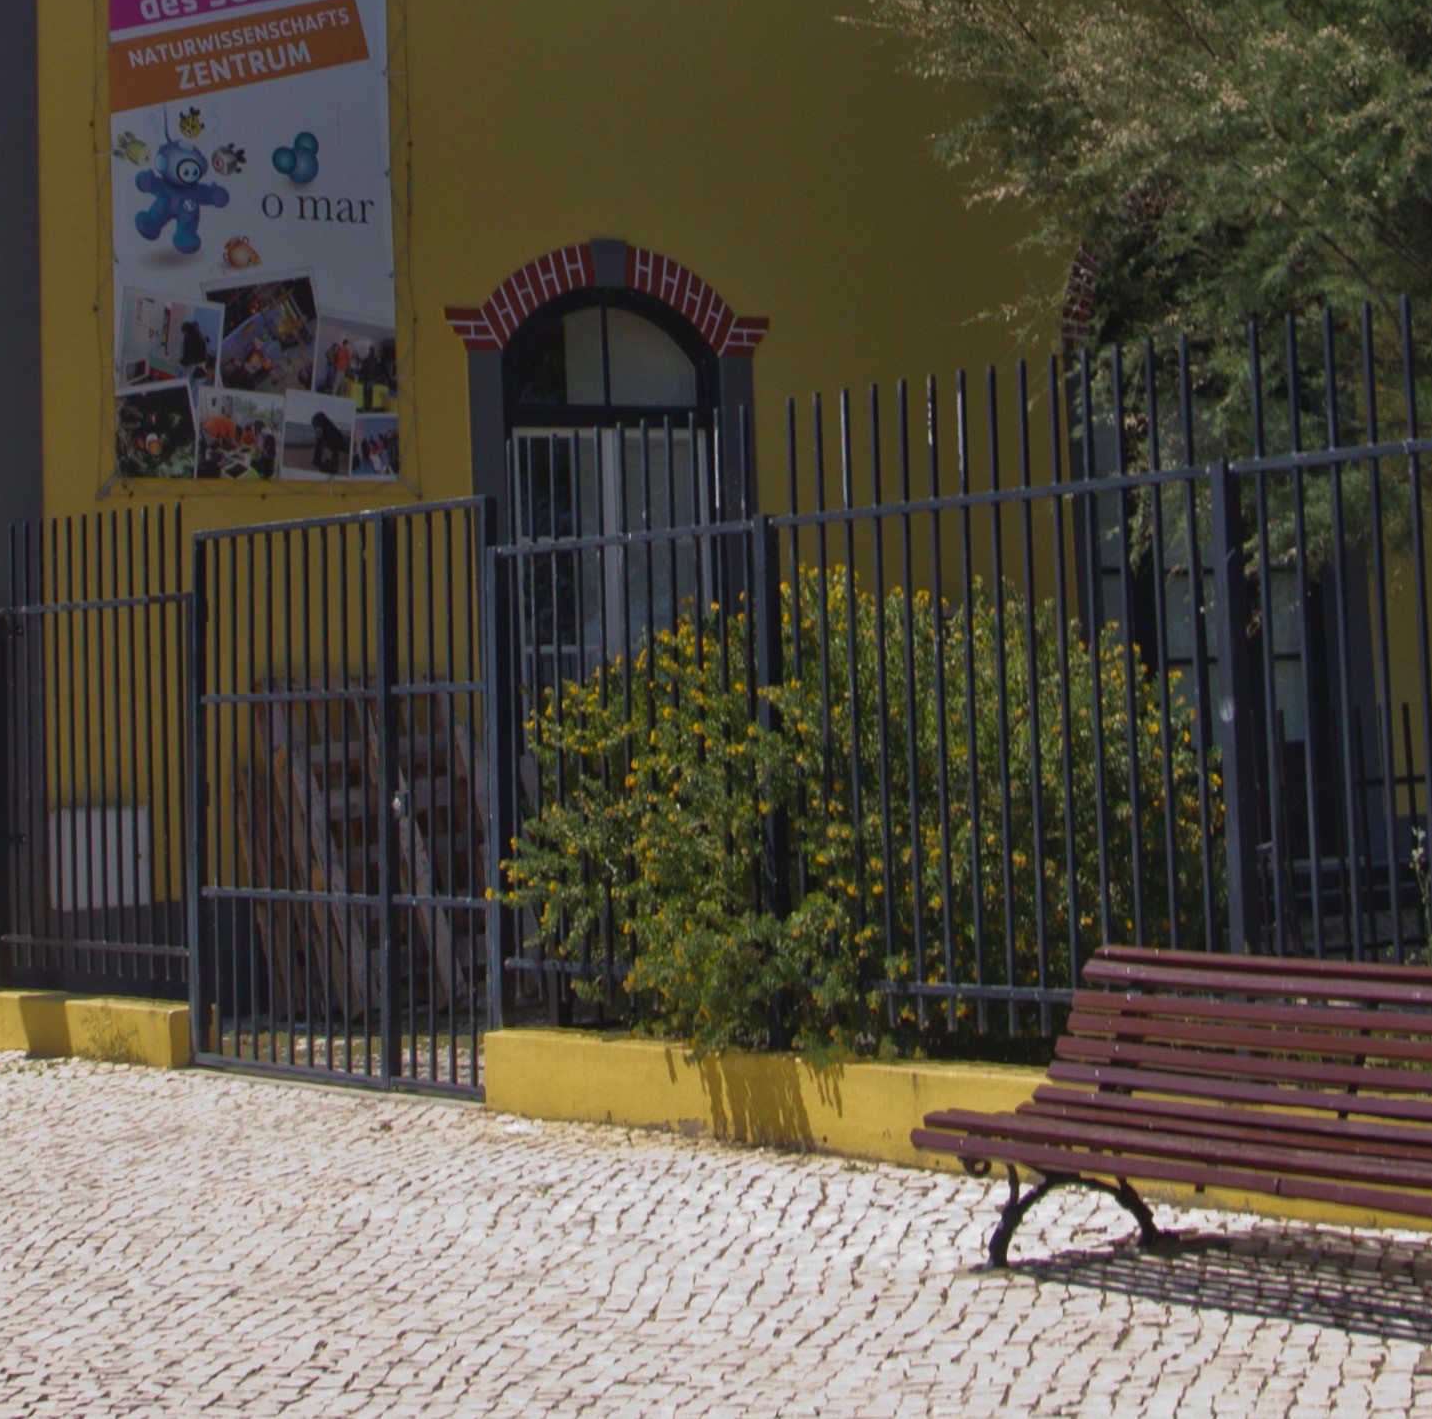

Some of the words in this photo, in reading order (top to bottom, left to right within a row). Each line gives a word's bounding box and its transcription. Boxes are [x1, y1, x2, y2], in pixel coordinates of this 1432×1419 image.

[128, 6, 351, 69] NATURWISSENSCHAFTS
[175, 40, 311, 90] ZENTRUM
[261, 192, 284, 219] o
[296, 192, 375, 225] mar
